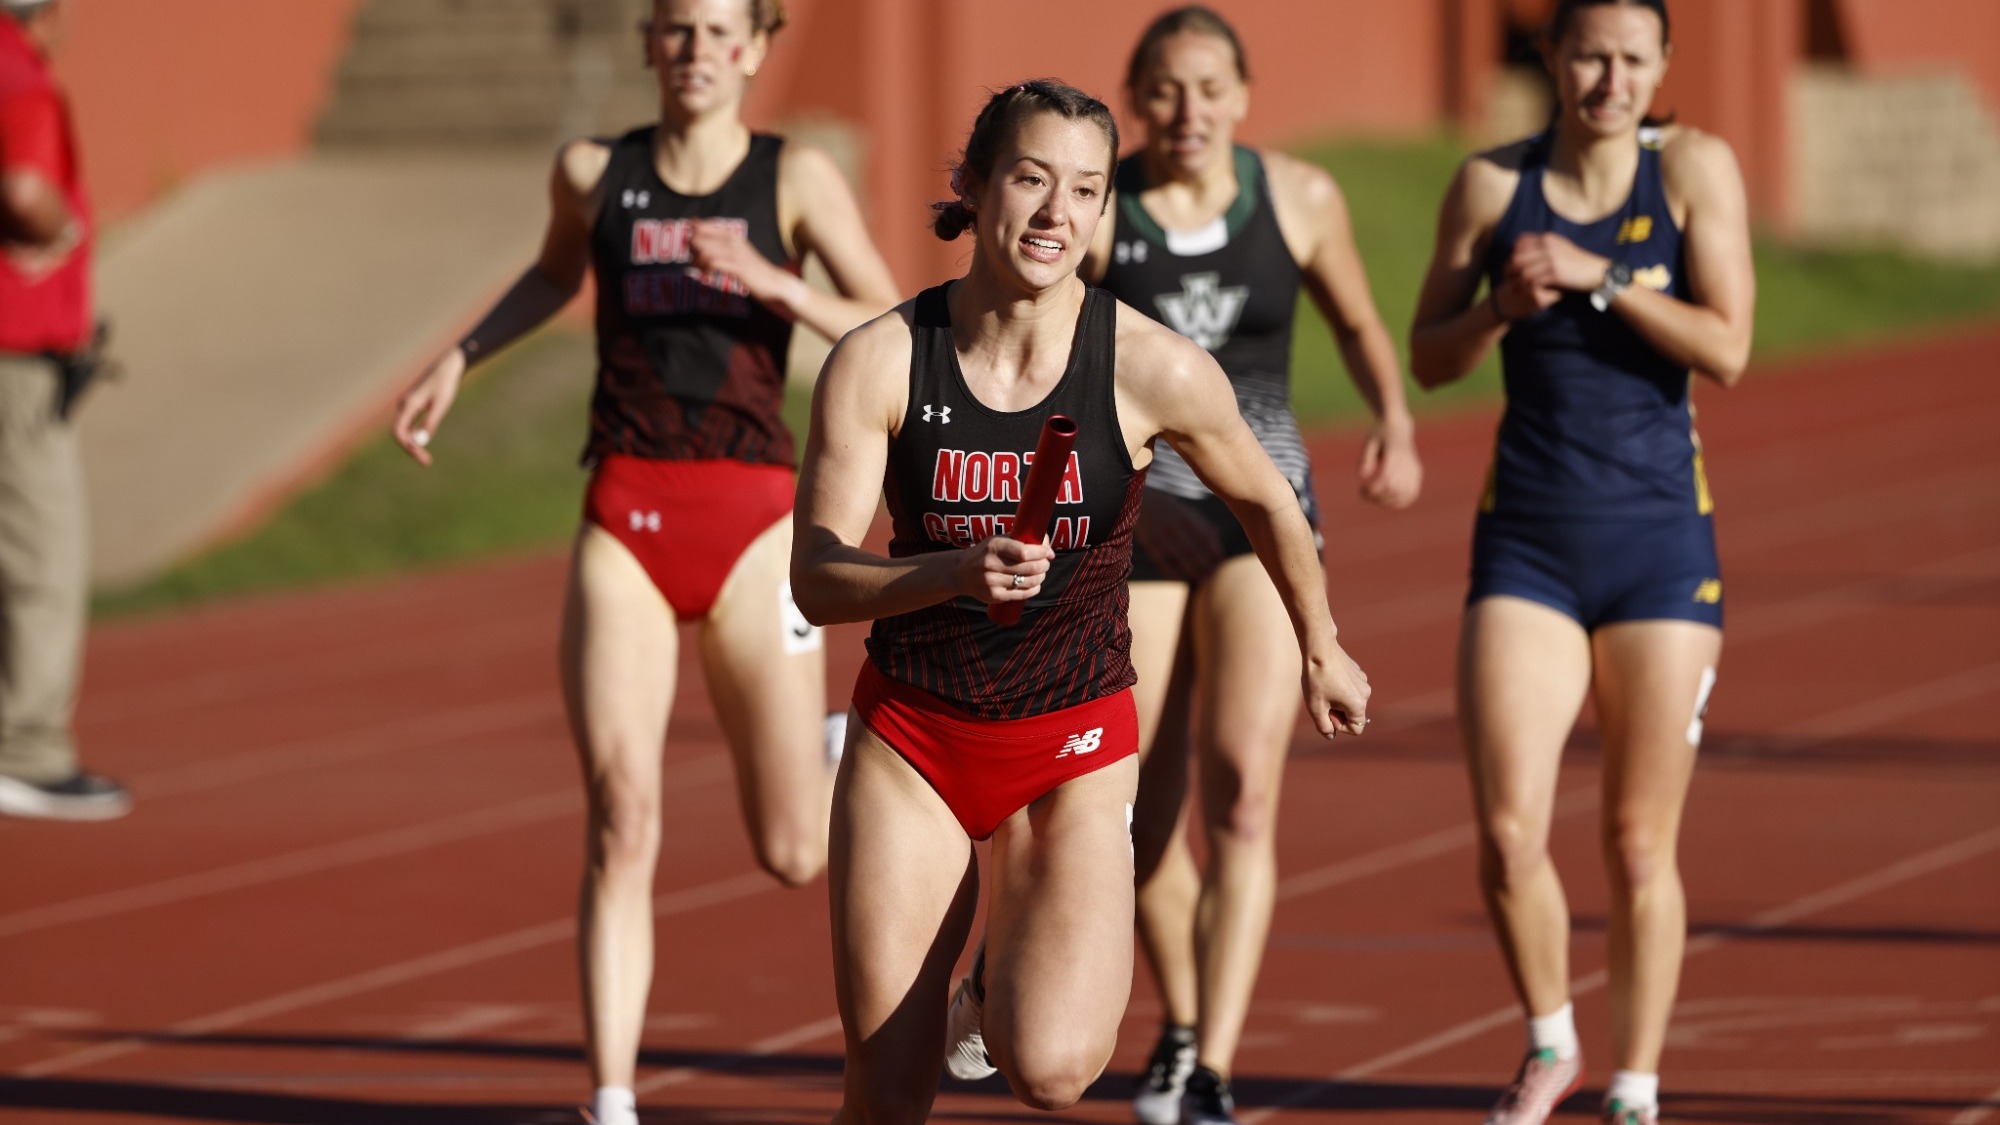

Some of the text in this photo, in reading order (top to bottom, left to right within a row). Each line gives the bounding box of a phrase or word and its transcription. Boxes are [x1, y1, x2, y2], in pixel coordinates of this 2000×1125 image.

[631, 218, 748, 264] NOR
[932, 449, 1083, 503] NORH
[923, 512, 1090, 549] CENAL
[1055, 727, 1103, 758] NB
